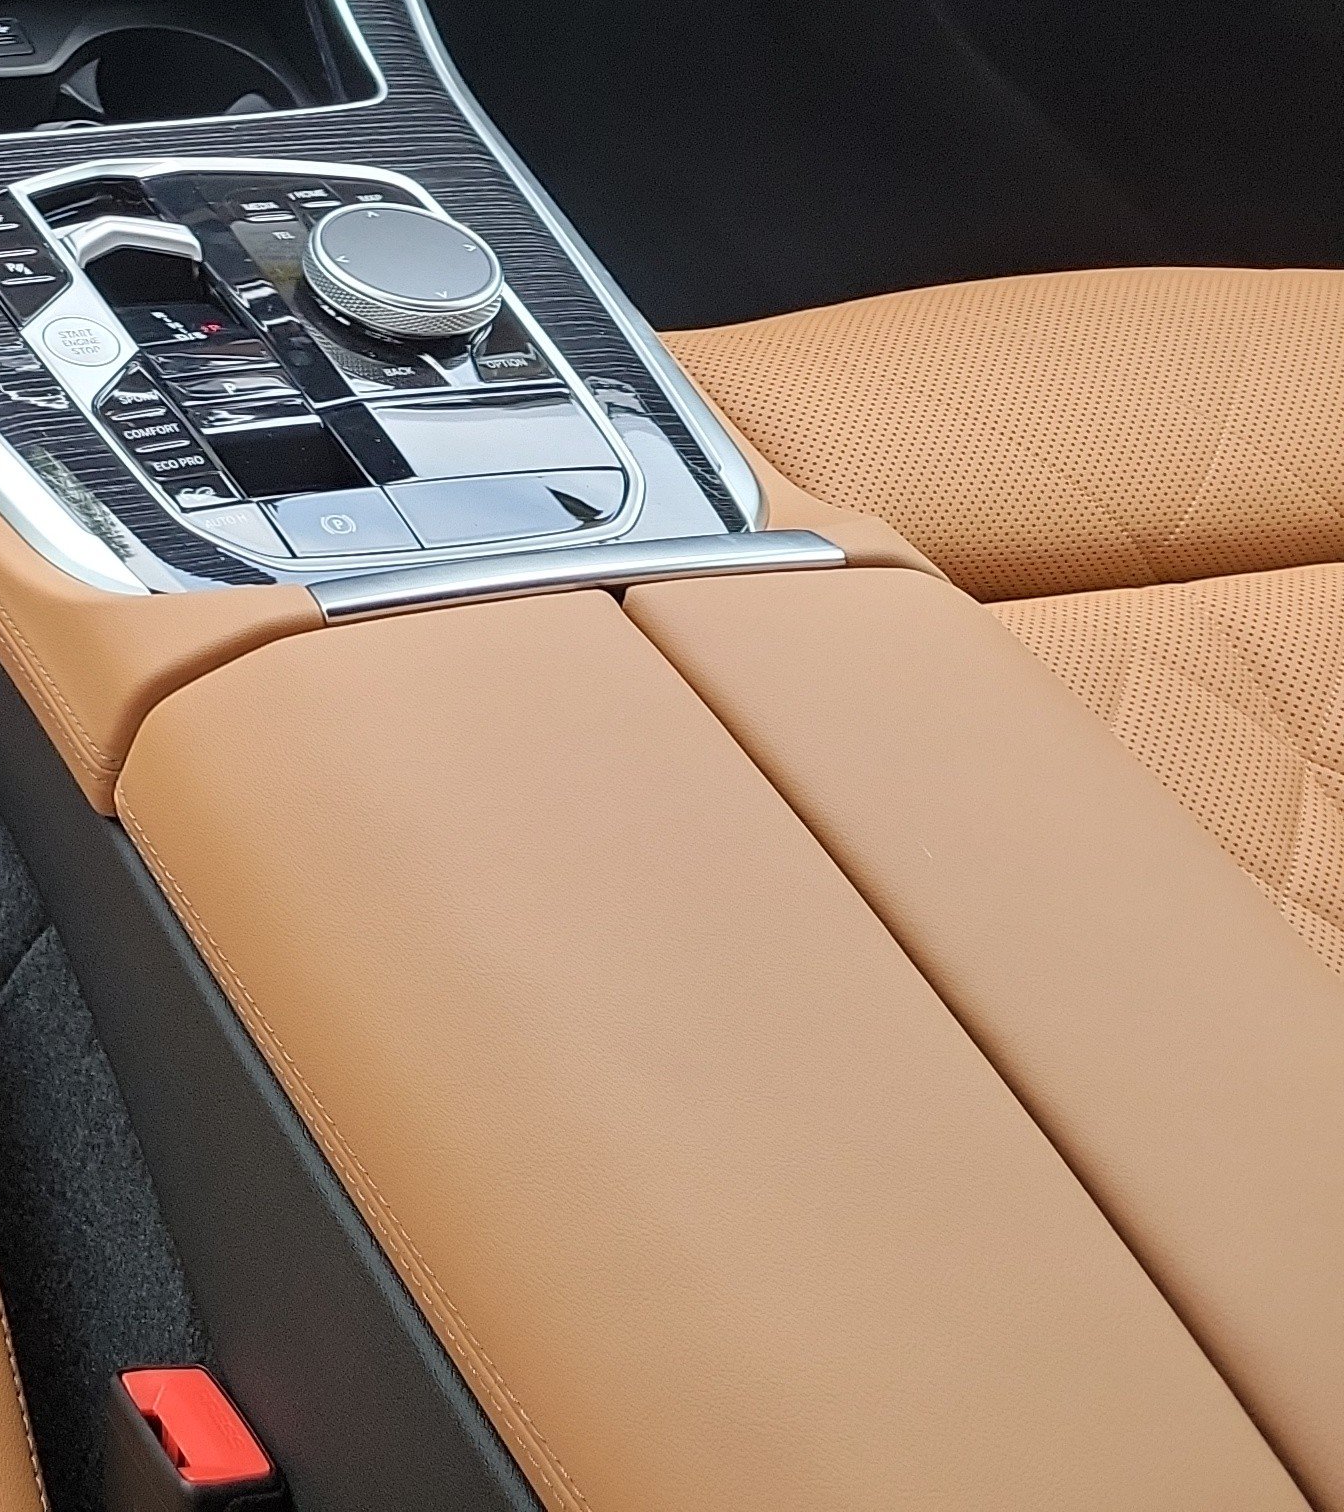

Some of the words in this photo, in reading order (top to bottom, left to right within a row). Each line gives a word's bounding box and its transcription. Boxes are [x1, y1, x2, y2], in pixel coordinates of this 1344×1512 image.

[58, 328, 94, 339] START
[62, 337, 99, 348] ENGINE
[71, 346, 101, 355] STOP
[485, 357, 529, 370] OPTION
[383, 365, 416, 377] BACK
[123, 422, 181, 440] COMFORT
[153, 457, 178, 472] ECO
[179, 455, 205, 469] PRO
